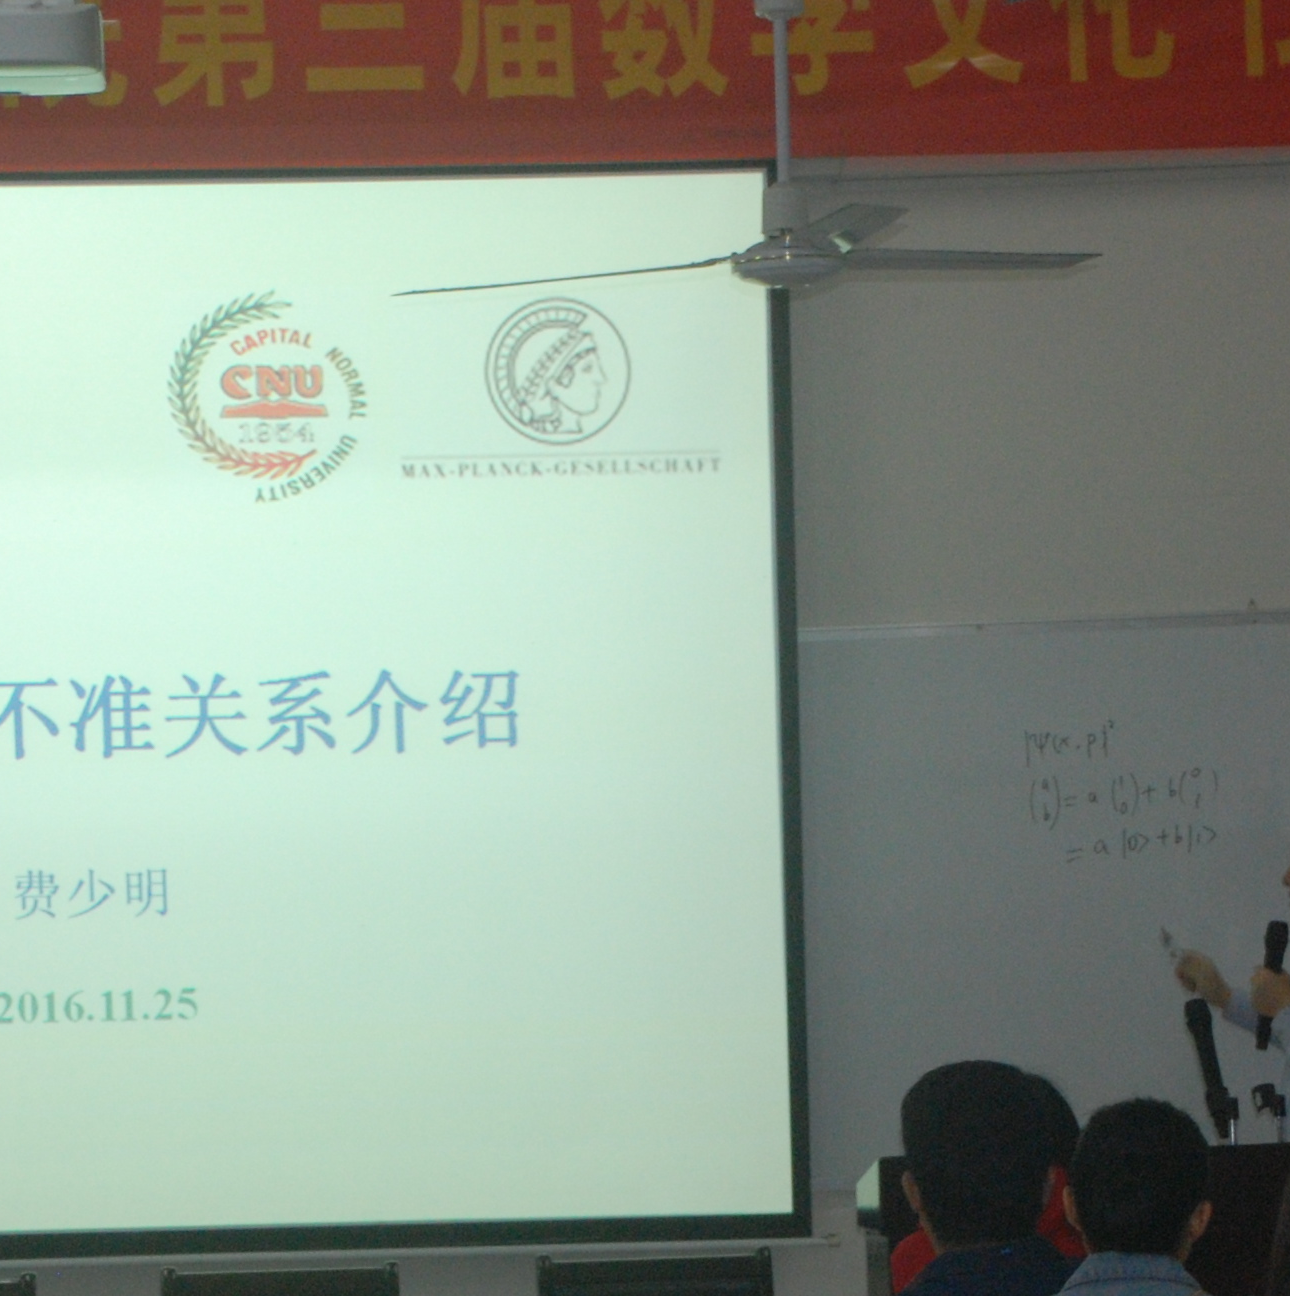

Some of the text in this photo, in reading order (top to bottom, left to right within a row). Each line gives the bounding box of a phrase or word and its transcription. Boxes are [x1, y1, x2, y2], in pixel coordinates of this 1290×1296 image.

[229, 328, 312, 357] CAPITAL
[220, 364, 323, 400] CNU
[325, 347, 368, 420] NORMAL
[254, 434, 359, 503] UNIVERSITY
[400, 456, 723, 479] MAX-PLANCK-GESELLSCHAFT
[15, 868, 169, 921] 费少明
